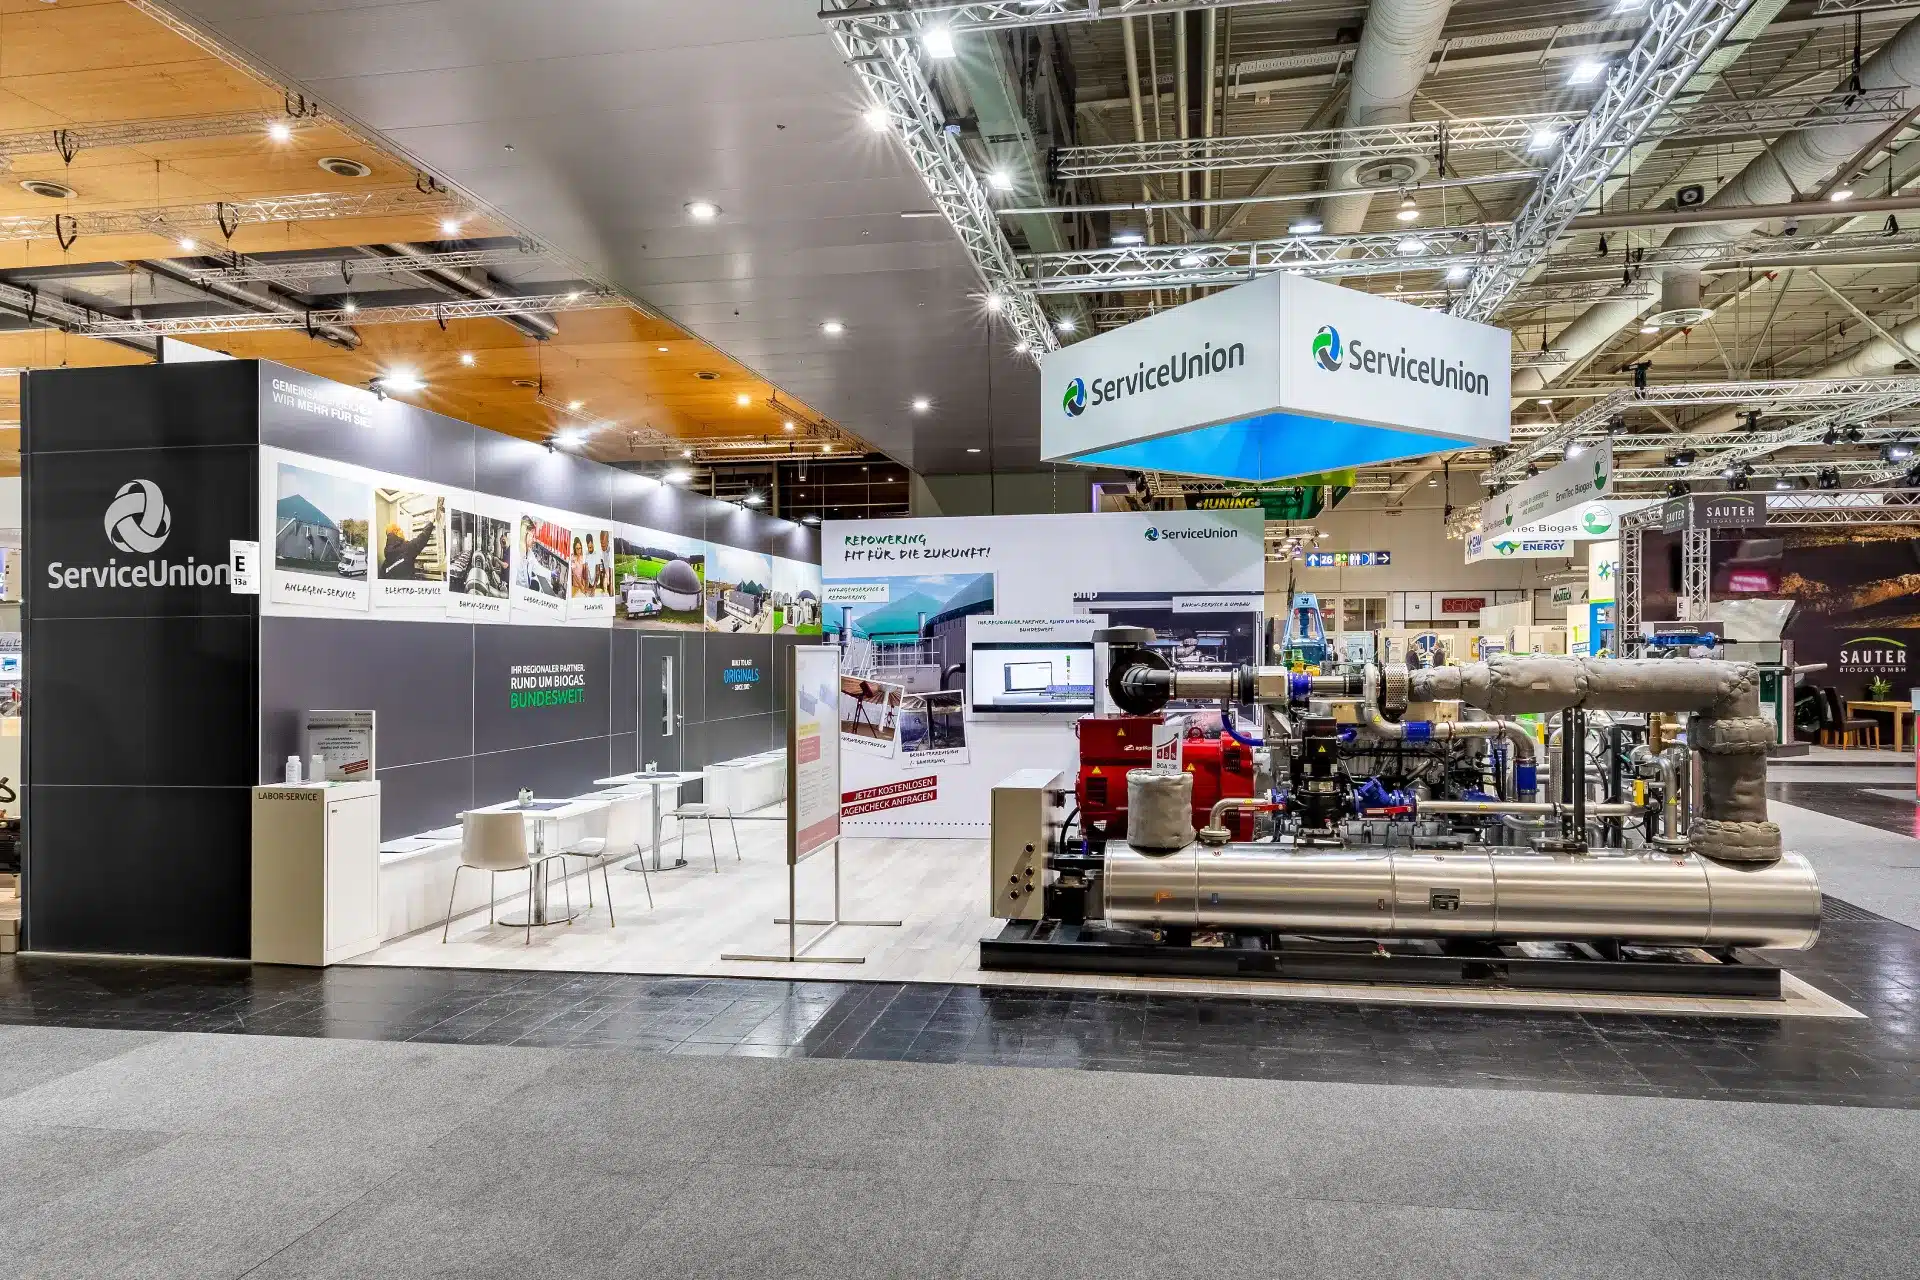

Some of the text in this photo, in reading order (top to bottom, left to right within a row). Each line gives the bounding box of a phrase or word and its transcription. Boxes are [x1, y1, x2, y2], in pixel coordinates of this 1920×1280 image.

[1091, 339, 1245, 406] ServiceUnion
[1348, 339, 1490, 397] ServiceUnion
[272, 379, 321, 402] GEMEINSA
[272, 390, 295, 408] WIR
[297, 398, 329, 417] MEHR
[331, 407, 352, 423] FÜR
[1574, 480, 1593, 495] Biogas
[1666, 509, 1685, 523] SAUTER
[1706, 506, 1755, 517] SAUTER
[1161, 527, 1239, 540] ServiceUnion
[1538, 524, 1578, 533] Biogas
[844, 534, 927, 546] REPOWERING
[1522, 543, 1565, 551] ENERGY
[844, 547, 991, 562] FIT FÜR DIE ZUKUNFT!
[1321, 555, 1334, 565] 26
[235, 555, 246, 572] E
[47, 556, 231, 590] ServiceUnion
[234, 578, 247, 586] 13a
[284, 582, 357, 600] ANLAGEN-SERVICE
[385, 586, 442, 595] ELEKTRO-SERVICE
[1840, 650, 1907, 664] SAUTER
[510, 663, 586, 675] IHR REGIONALER PARTNER.
[723, 668, 760, 684] ORIGINALS
[510, 674, 586, 690] RUND UM BIOGAS.
[510, 688, 586, 709] BUNDESWEIT.
[258, 792, 318, 801] LABOR-SERVICE
[853, 778, 934, 801] JETZT KOSTENLOSEN
[891, 791, 934, 807] ANFRAGEN
